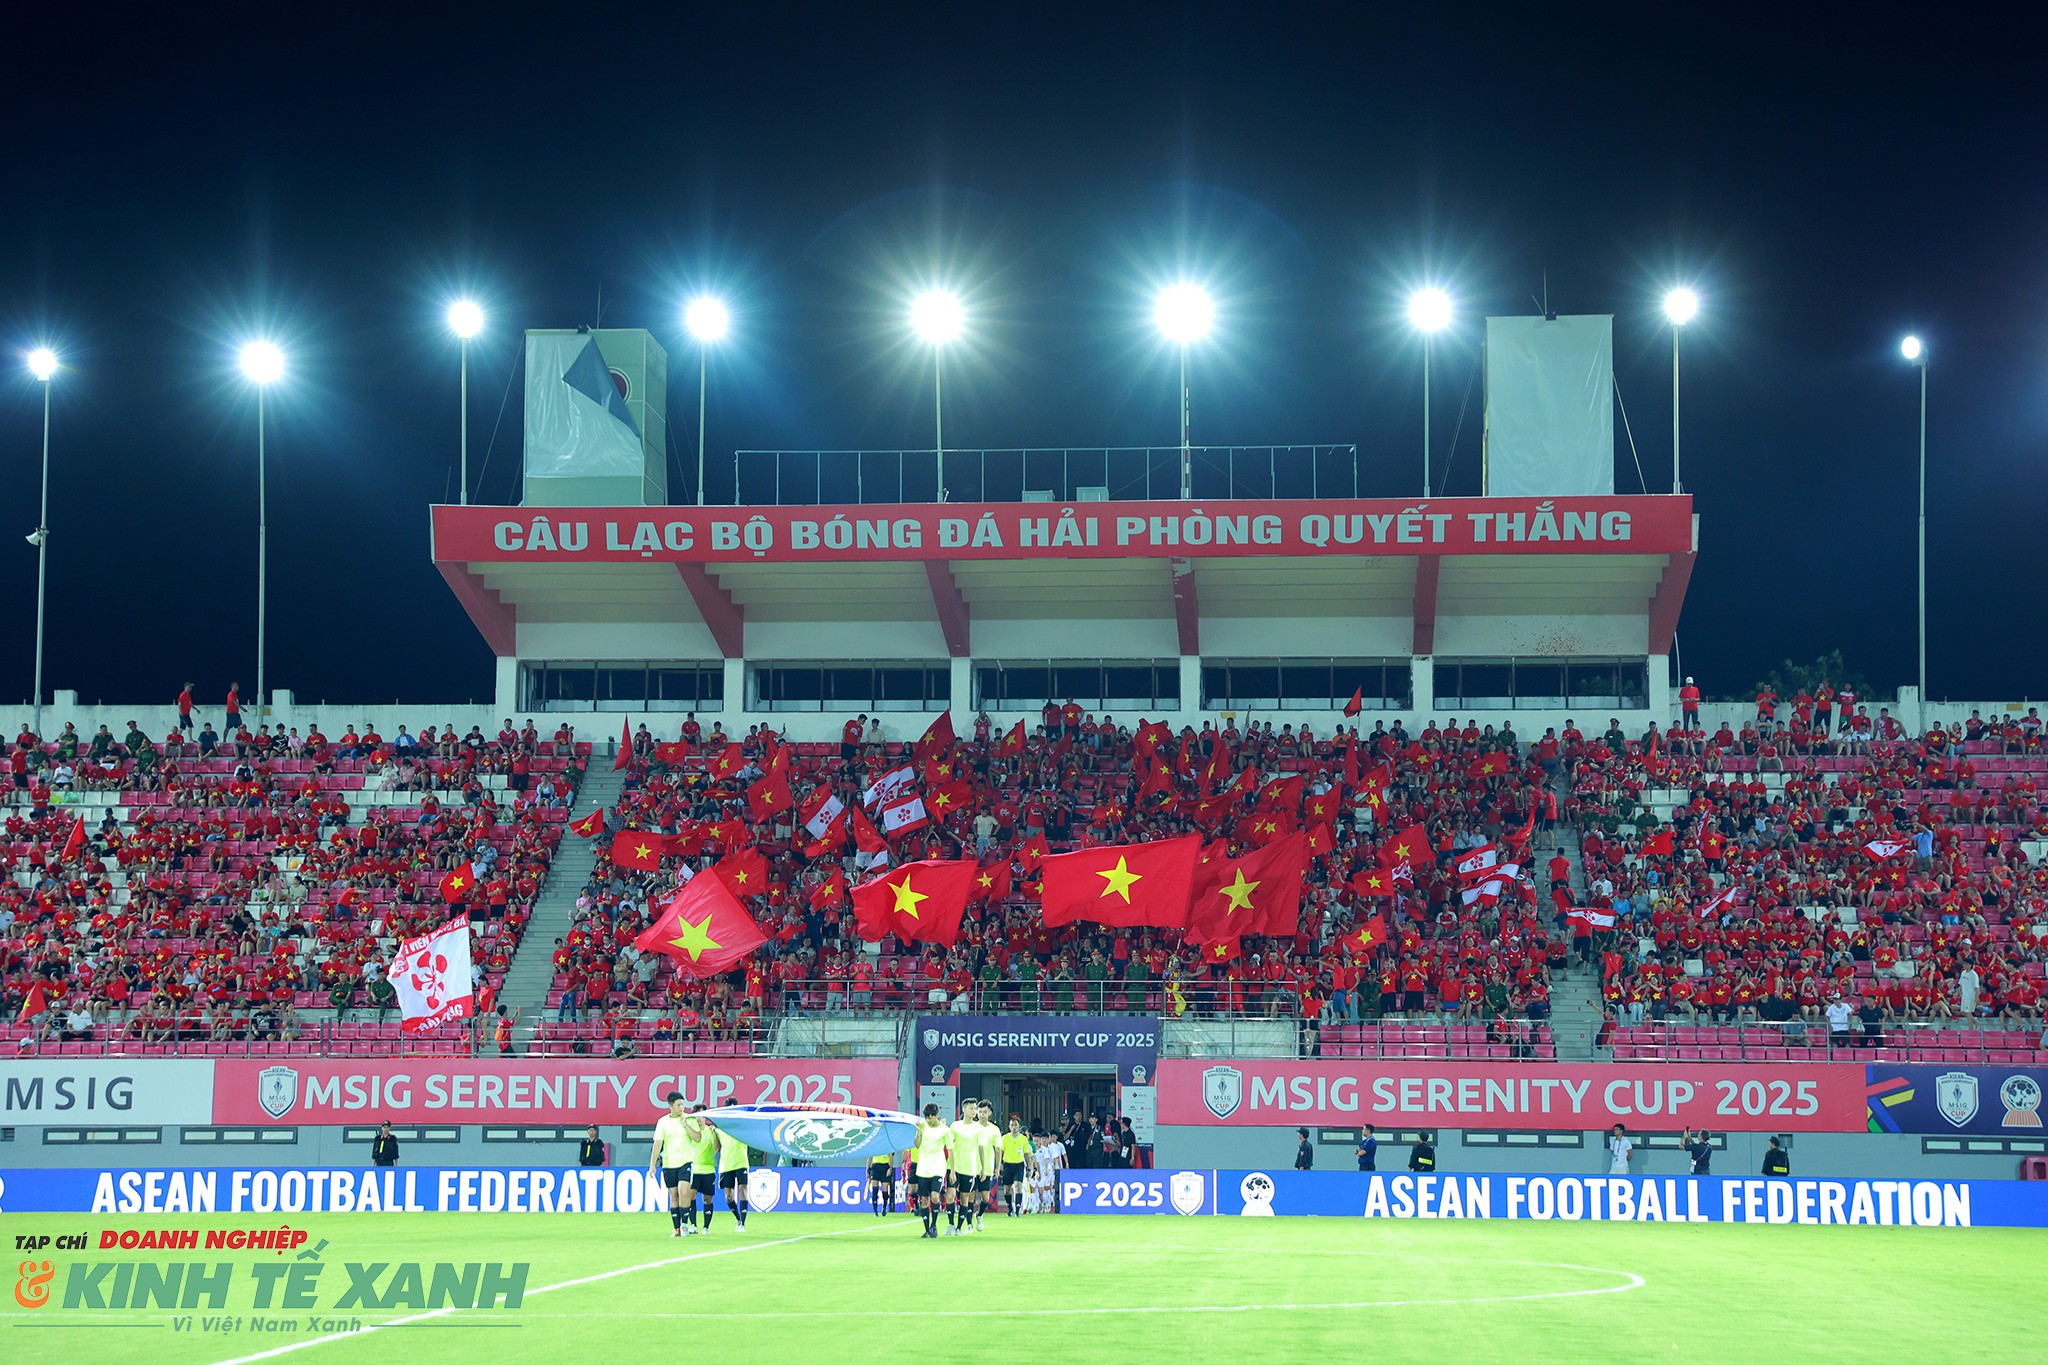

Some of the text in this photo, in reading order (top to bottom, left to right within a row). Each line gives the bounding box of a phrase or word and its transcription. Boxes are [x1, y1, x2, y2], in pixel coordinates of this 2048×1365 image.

[493, 499, 1632, 557] CÂU LẠC BỘ BÓNG ĐÁ HẢI PHÒNG QUYẾT THẮNG
[942, 1032, 984, 1047] MSIG
[988, 1032, 1071, 1047] SERENITY
[1116, 1032, 1155, 1047] 2025
[6, 1076, 134, 1111] MSIG
[303, 1073, 412, 1110] MSIG
[424, 1074, 638, 1109] SERENITY
[755, 1073, 853, 1107] 2025
[1250, 1075, 1359, 1112] MSIG
[1372, 1076, 1592, 1114] SERENITY
[1715, 1080, 1819, 1116] 2025
[91, 1169, 669, 1214] ASEAN FOOTBALL FEDERATION
[787, 1179, 861, 1206] MSIG
[1095, 1181, 1164, 1208] 2025
[1364, 1175, 1971, 1228] ASEAN FOOTBALL FEDERATION
